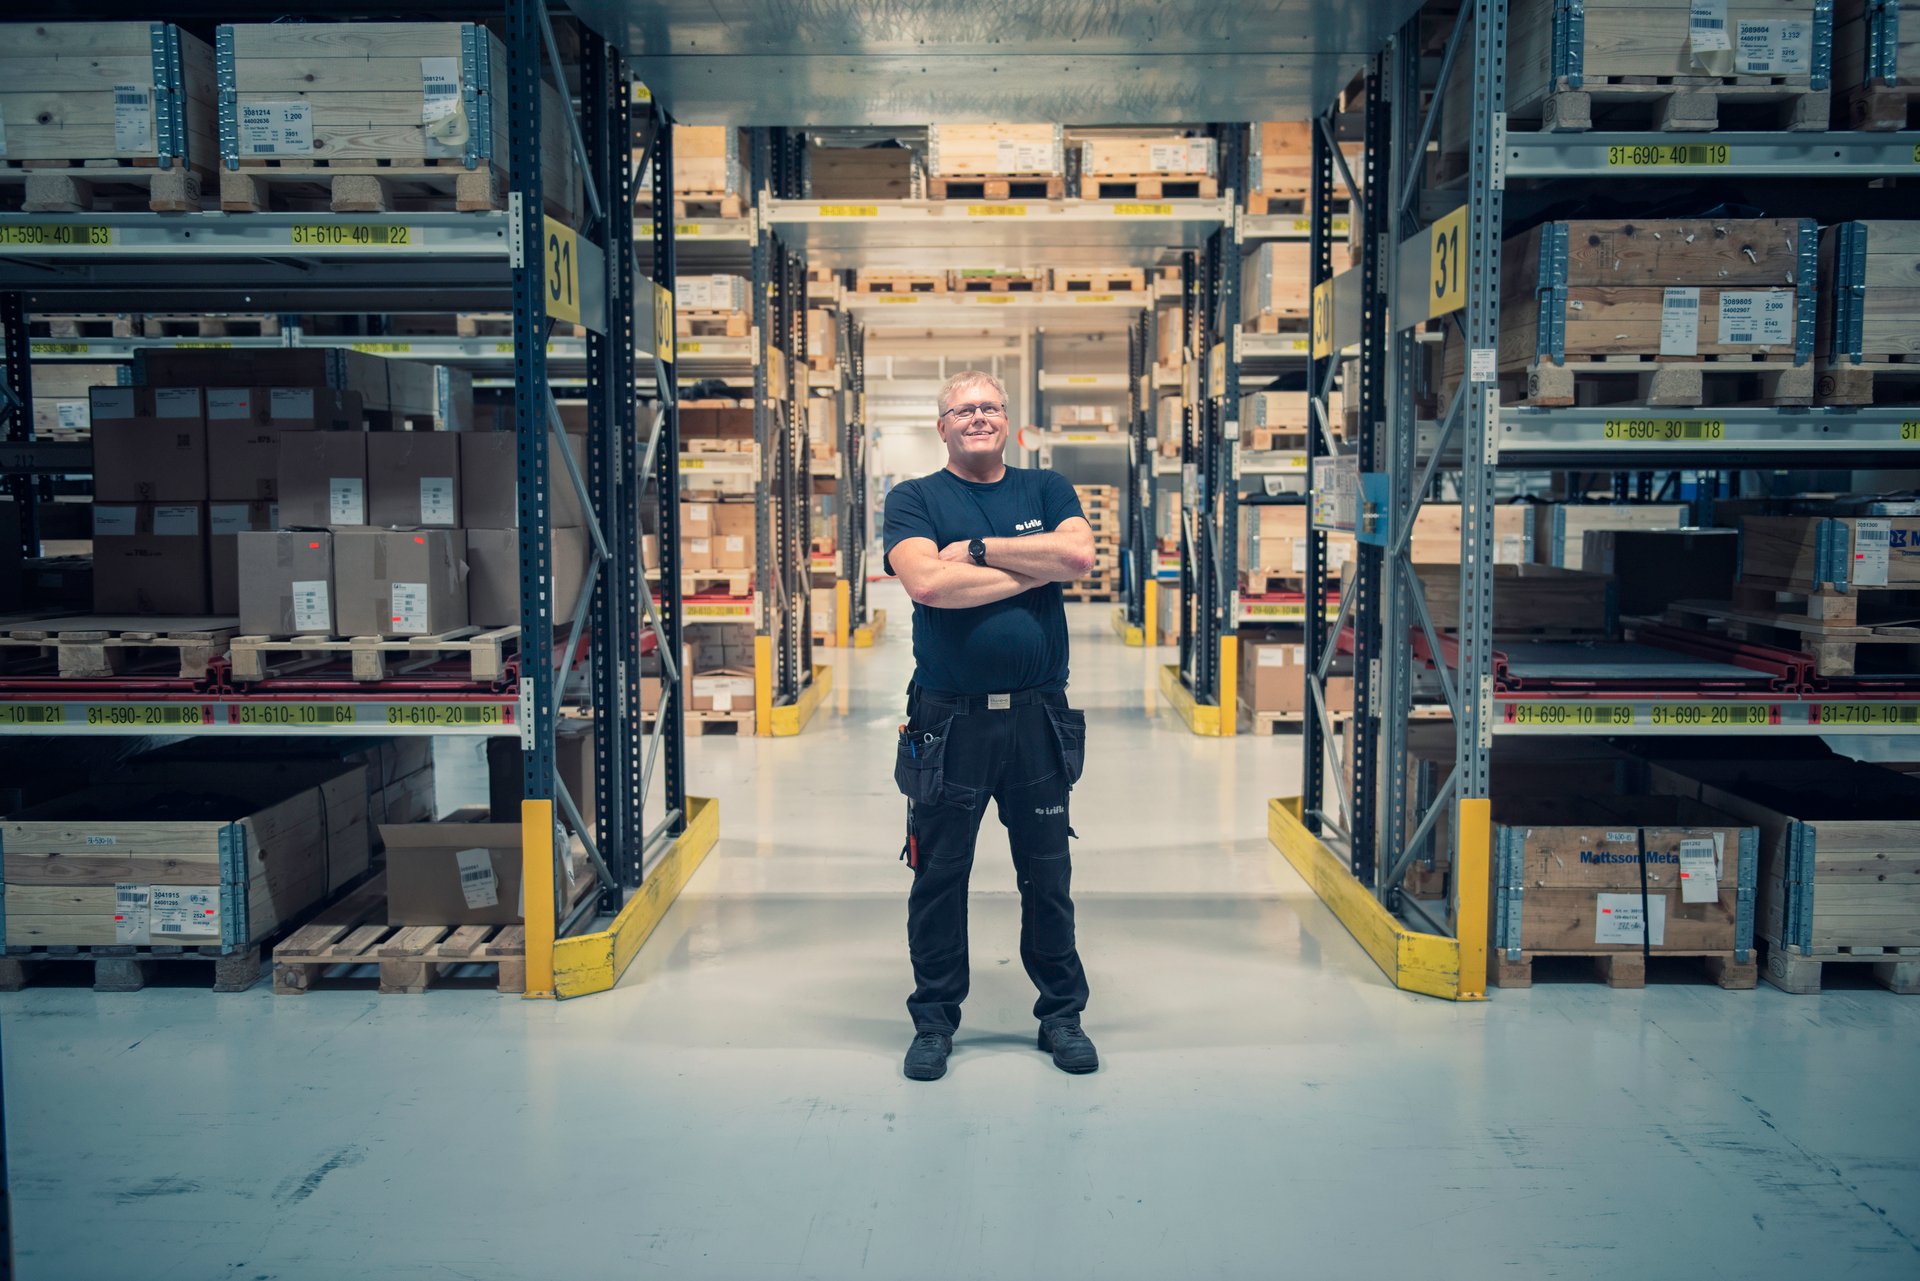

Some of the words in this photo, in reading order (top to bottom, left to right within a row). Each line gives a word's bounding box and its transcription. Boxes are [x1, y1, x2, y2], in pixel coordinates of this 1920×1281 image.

[1609, 146, 1665, 164] 31-690-
[1669, 146, 1687, 164] 40
[1709, 146, 1726, 164] 19
[54, 225, 71, 243] 40
[91, 225, 108, 243] 53
[293, 225, 348, 243] 31-610-
[352, 225, 369, 243] 40
[390, 225, 407, 243] 22
[549, 233, 573, 306] 31
[1435, 225, 1458, 298] 31
[658, 295, 670, 348] 30
[1316, 292, 1329, 344] 30
[1605, 421, 1661, 438] 31-690-
[1665, 421, 1682, 438] 30
[1704, 421, 1720, 438] 18
[8, 706, 25, 722] 10
[45, 706, 60, 722] 21
[88, 707, 141, 724] 31-590-
[145, 707, 162, 723] 20
[182, 707, 199, 723] 86
[242, 706, 294, 723] 31-610-
[299, 706, 315, 723] 10
[335, 706, 353, 723] 64
[388, 706, 441, 723] 31-610-
[446, 706, 462, 723] 20
[482, 706, 498, 723] 51
[1517, 706, 1571, 723] 31-690-
[1577, 706, 1592, 723] 10
[1613, 706, 1630, 723] 59
[1652, 706, 1707, 723] 31-690-
[1711, 706, 1728, 723] 20
[1749, 706, 1766, 723] 30
[1822, 706, 1876, 723] 31-710-
[1881, 706, 1898, 723] 10
[1580, 851, 1641, 864] Mattsson
